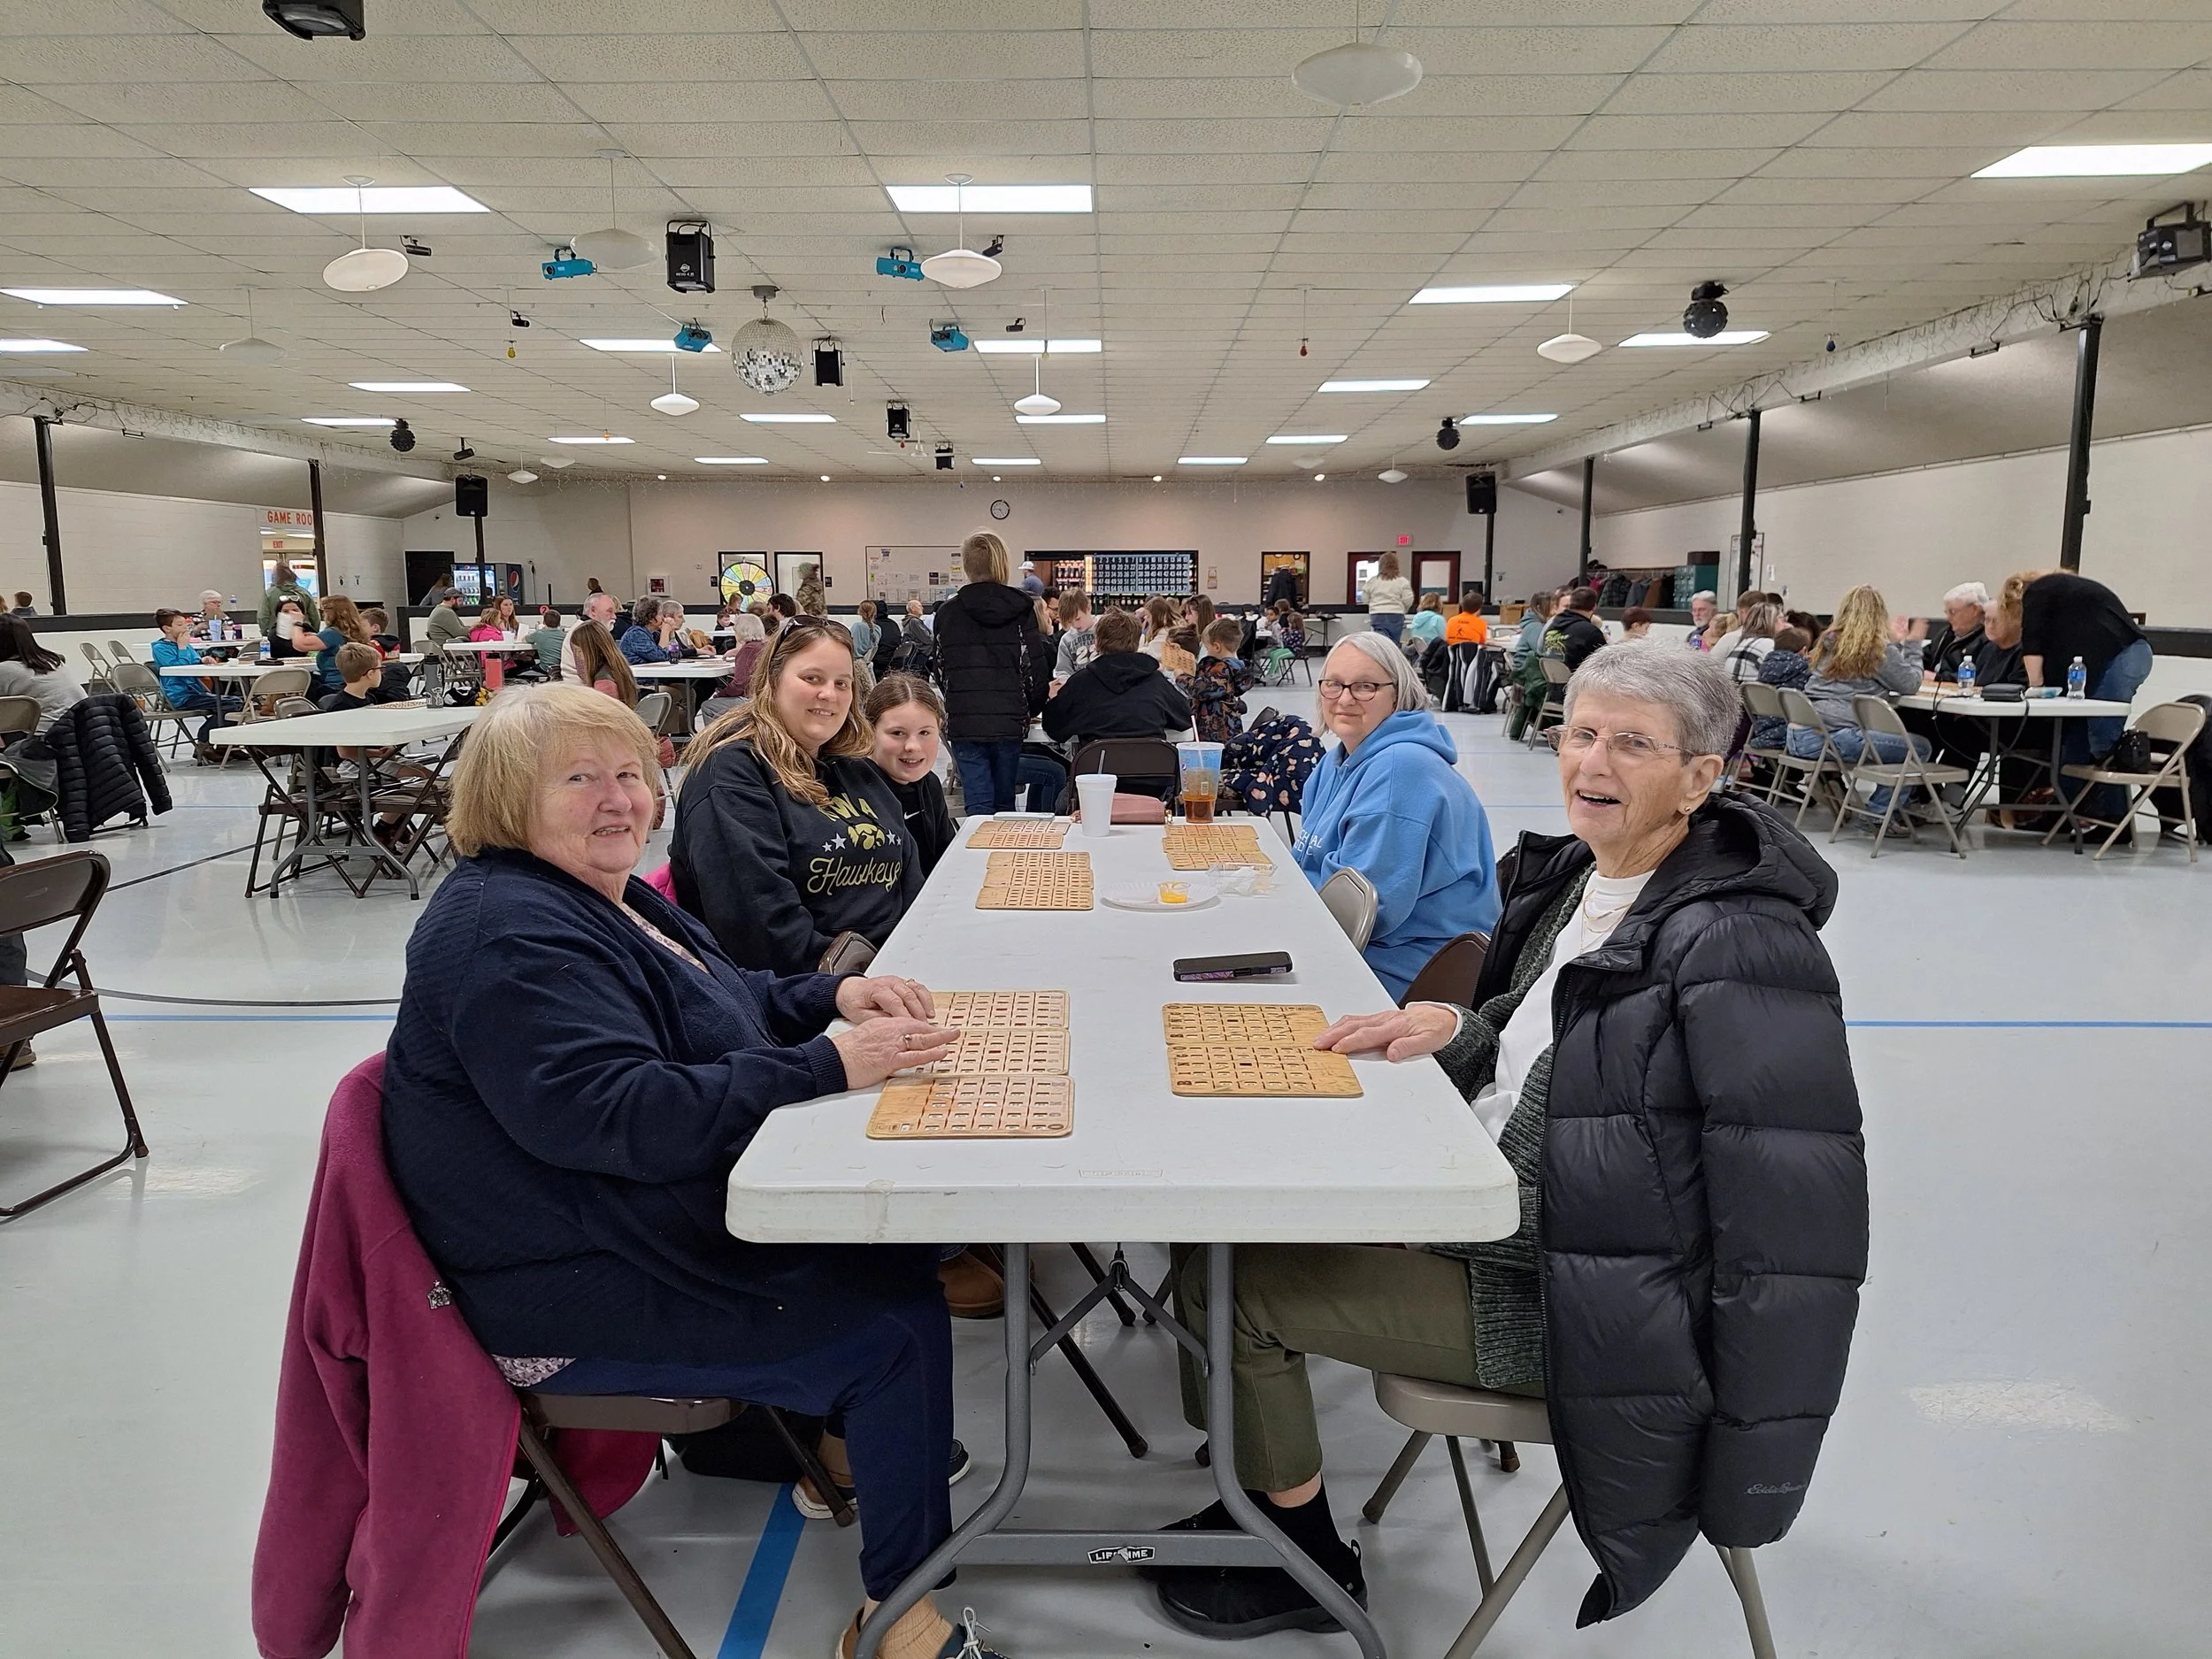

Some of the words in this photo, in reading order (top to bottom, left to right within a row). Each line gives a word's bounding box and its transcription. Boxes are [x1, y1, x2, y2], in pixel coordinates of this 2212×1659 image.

[267, 511, 291, 524] GAME
[296, 513, 312, 525] ROO
[1076, 646, 1102, 664] 22
[1095, 1549, 1148, 1561] LIFIME
